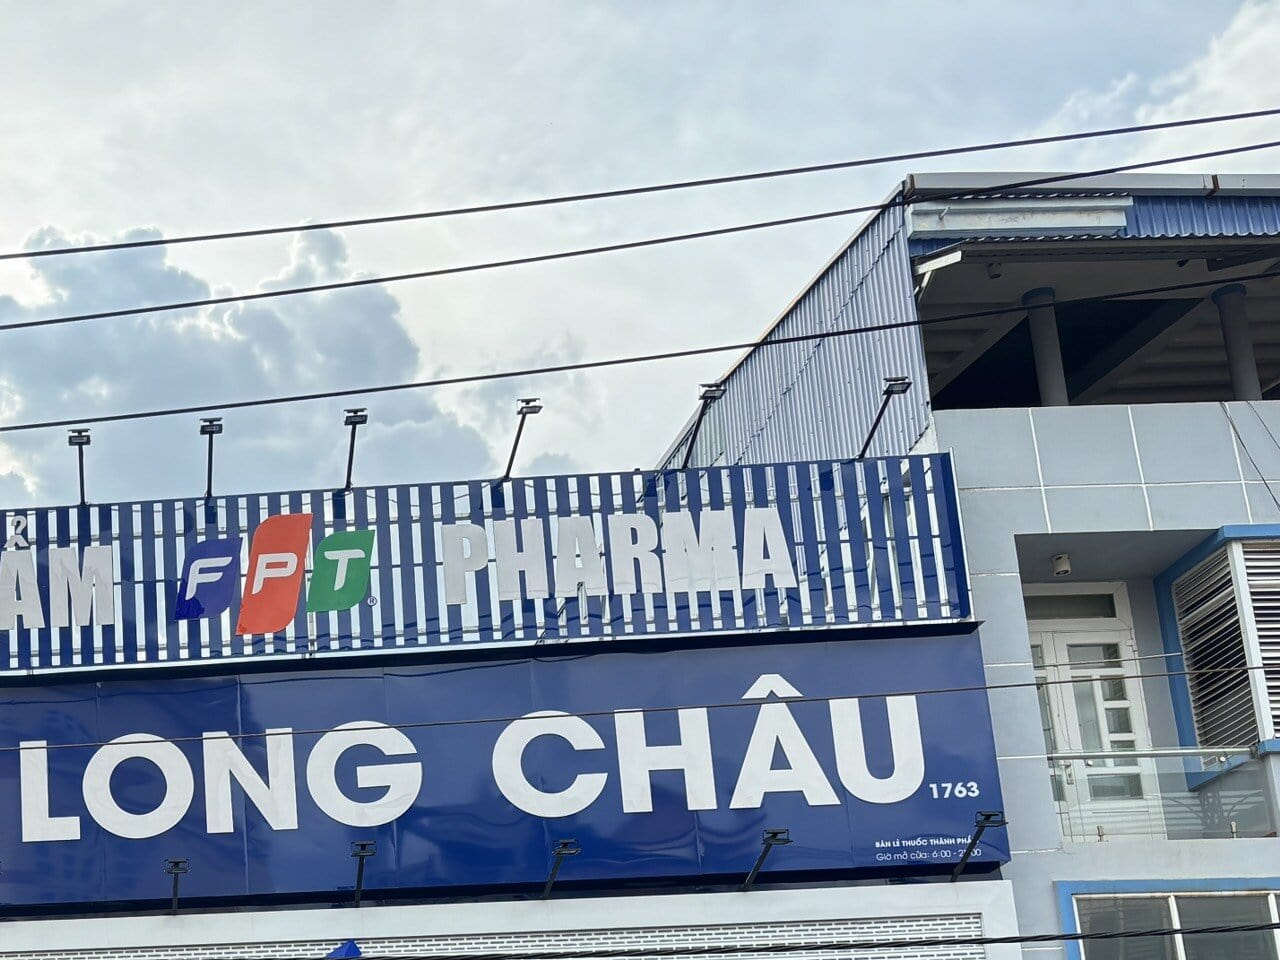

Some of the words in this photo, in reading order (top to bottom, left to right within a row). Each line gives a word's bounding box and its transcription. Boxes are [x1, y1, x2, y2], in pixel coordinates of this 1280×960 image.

[441, 507, 798, 606] PHARMA
[19, 720, 423, 843] LONG
[491, 673, 926, 819] CHÂU
[929, 781, 980, 799] 1763
[932, 849, 951, 859] 6:00
